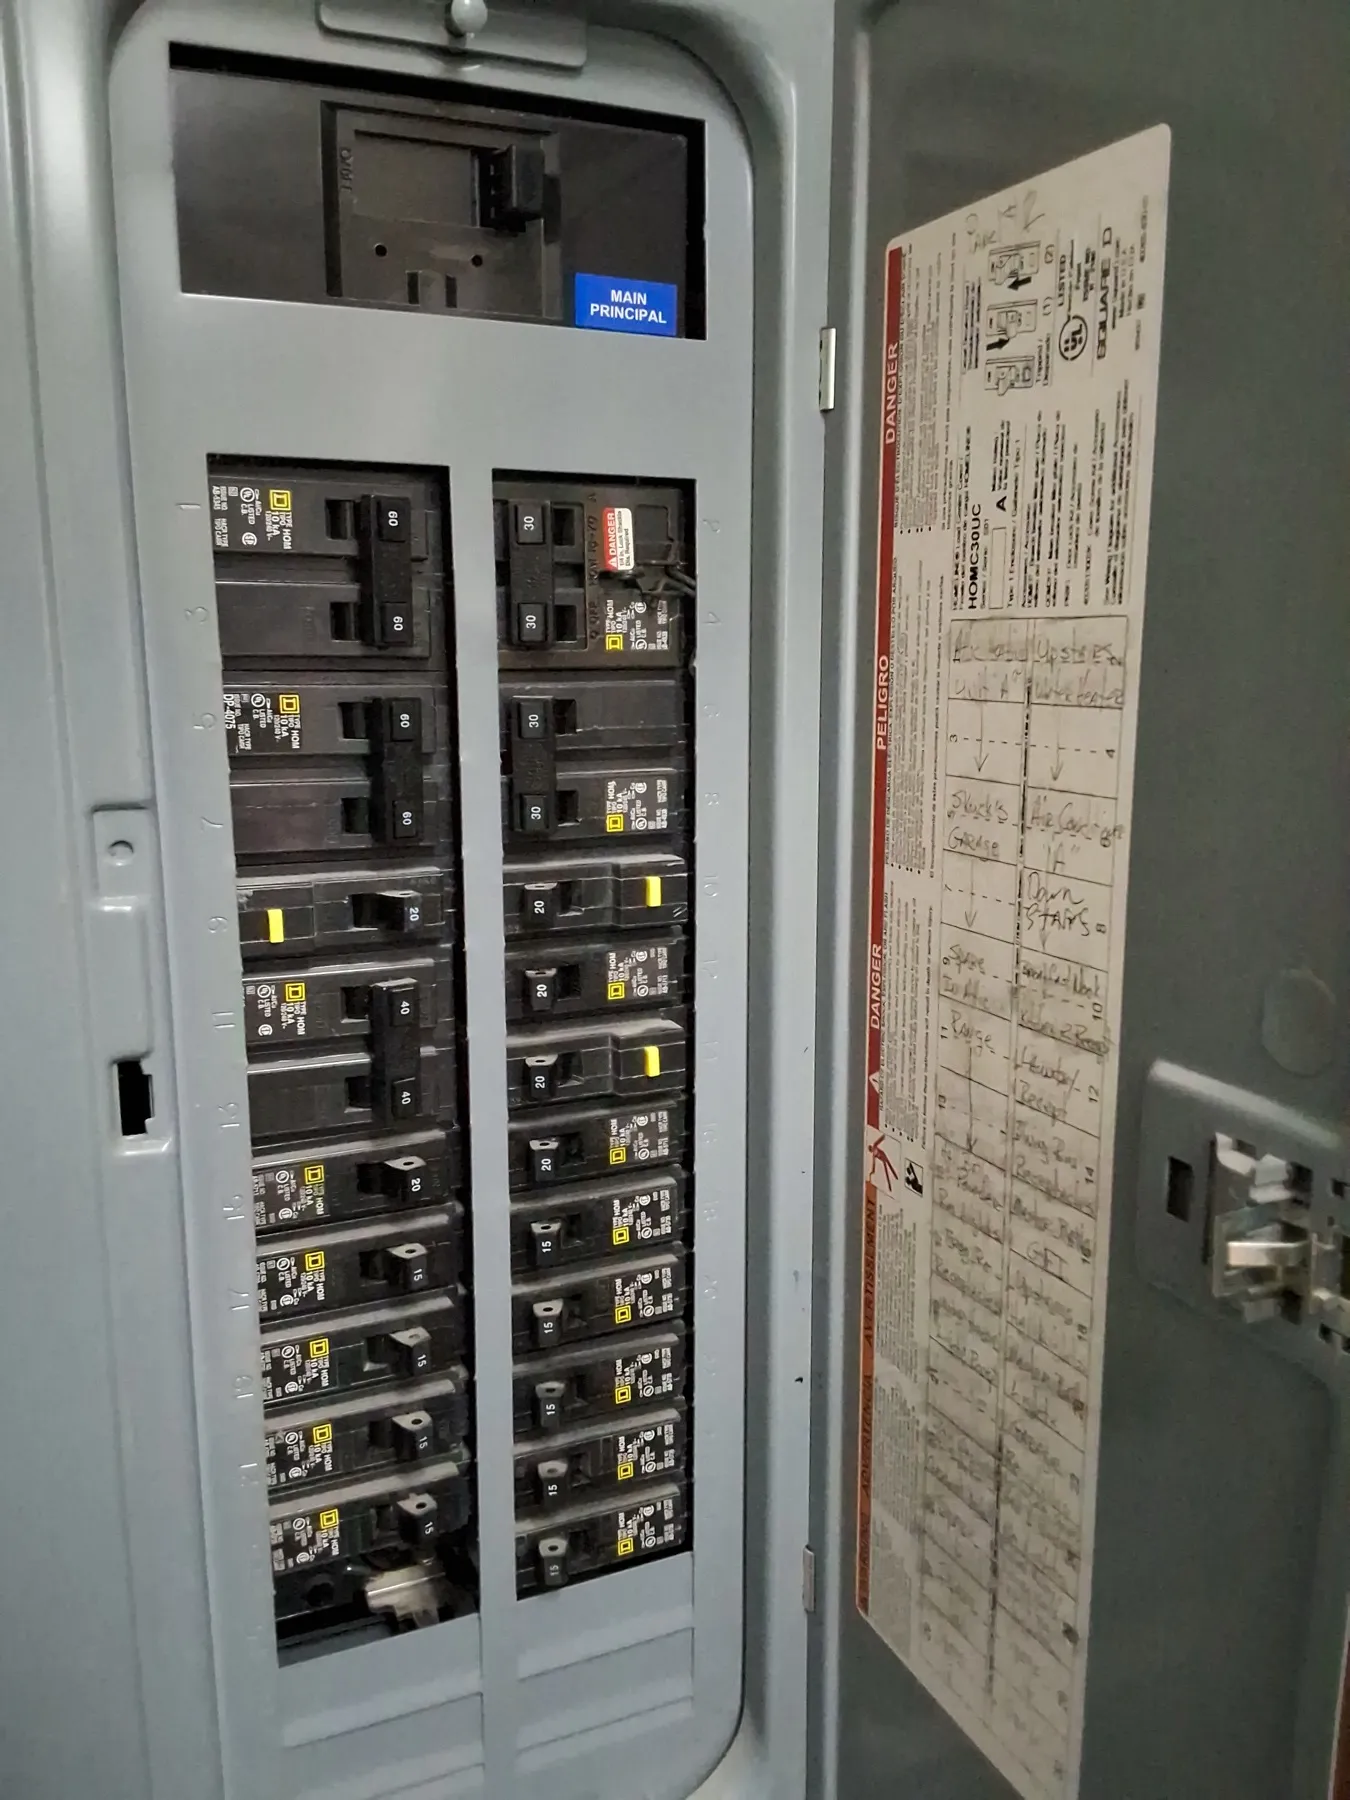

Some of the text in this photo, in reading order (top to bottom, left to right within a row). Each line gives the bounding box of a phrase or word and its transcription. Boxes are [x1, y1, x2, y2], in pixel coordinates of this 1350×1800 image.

[1045, 244, 1055, 264] (2)
[1058, 254, 1067, 306] LISTED
[611, 289, 647, 305] MAIN
[1097, 226, 1113, 359] SQUARE D
[589, 303, 667, 325] PRINCIPAL
[886, 342, 899, 444] DANGER
[996, 495, 1007, 512] A
[272, 511, 280, 536] 10 kA
[389, 511, 398, 526] 60
[524, 516, 534, 530] 30
[283, 529, 291, 549] HOM
[608, 512, 616, 556] DANGER
[968, 503, 981, 609] HOMC30UC
[394, 616, 403, 630] 60
[526, 615, 536, 629] 30
[616, 623, 622, 632] 10
[877, 655, 889, 750] PELIGRO
[223, 694, 235, 729] DP-4075
[280, 715, 289, 737] 10 kA
[400, 714, 409, 728] 60
[529, 714, 538, 728] 30
[291, 730, 299, 748] HOM
[531, 806, 541, 819] 30
[616, 804, 622, 812] 10
[402, 812, 412, 825] 60
[535, 900, 544, 913] 20
[409, 907, 418, 921] 20
[942, 956, 950, 965] 9
[537, 984, 547, 997] 20
[870, 943, 882, 1029] DANGER
[287, 1003, 295, 1024] 10 kA
[400, 1001, 409, 1015] 40
[1092, 1003, 1103, 1020] 10
[297, 1017, 305, 1035] HOM
[940, 1026, 948, 1040] 11
[535, 1076, 544, 1088] 20
[401, 1092, 411, 1104] 40
[1088, 1085, 1100, 1103] 12
[620, 1137, 625, 1146] 10
[542, 1158, 551, 1171] 20
[306, 1186, 312, 1194] 10
[411, 1178, 421, 1191] 20
[542, 1241, 551, 1252] 15
[306, 1272, 313, 1280] 10
[414, 1269, 422, 1281] 15
[316, 1283, 324, 1301] HOM
[544, 1322, 553, 1333] 15
[418, 1355, 426, 1367] 15
[546, 1404, 555, 1415] 15
[315, 1444, 320, 1453] 10
[419, 1436, 428, 1448] 15
[549, 1485, 557, 1495] 15
[321, 1530, 328, 1538] 10
[424, 1522, 434, 1534] 15
[550, 1565, 559, 1576] 15
